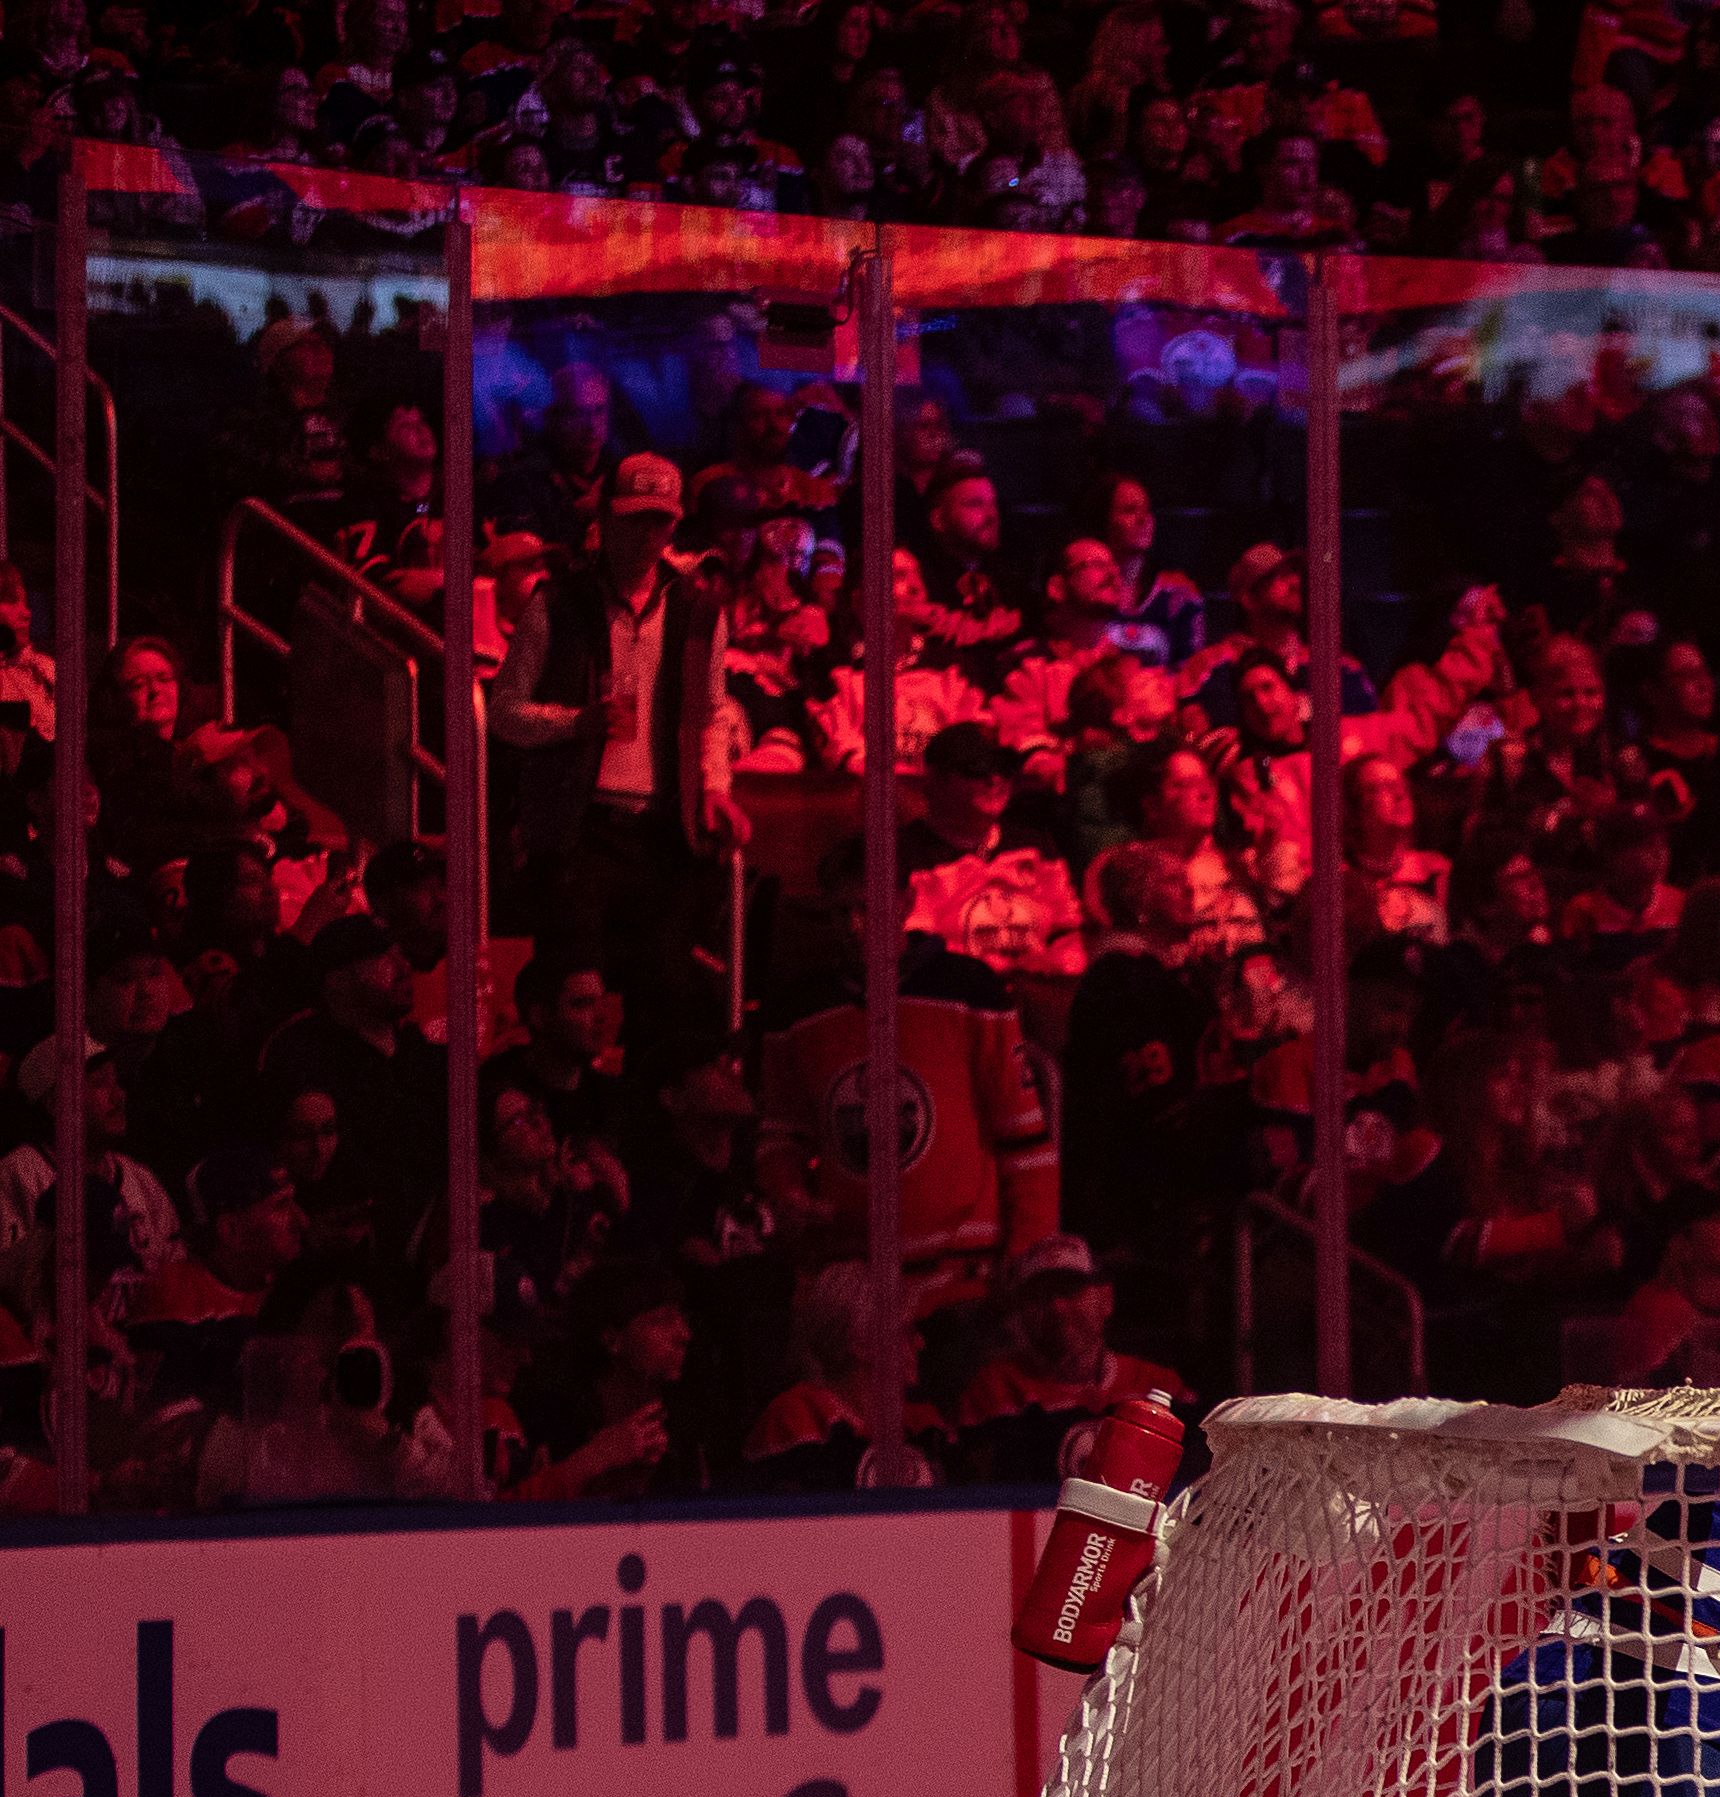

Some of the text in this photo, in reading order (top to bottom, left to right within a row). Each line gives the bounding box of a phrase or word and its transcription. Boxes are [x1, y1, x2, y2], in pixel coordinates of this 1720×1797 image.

[1052, 1531, 1108, 1645] BODYARMOR
[1089, 1536, 1117, 1593] Sports Drink
